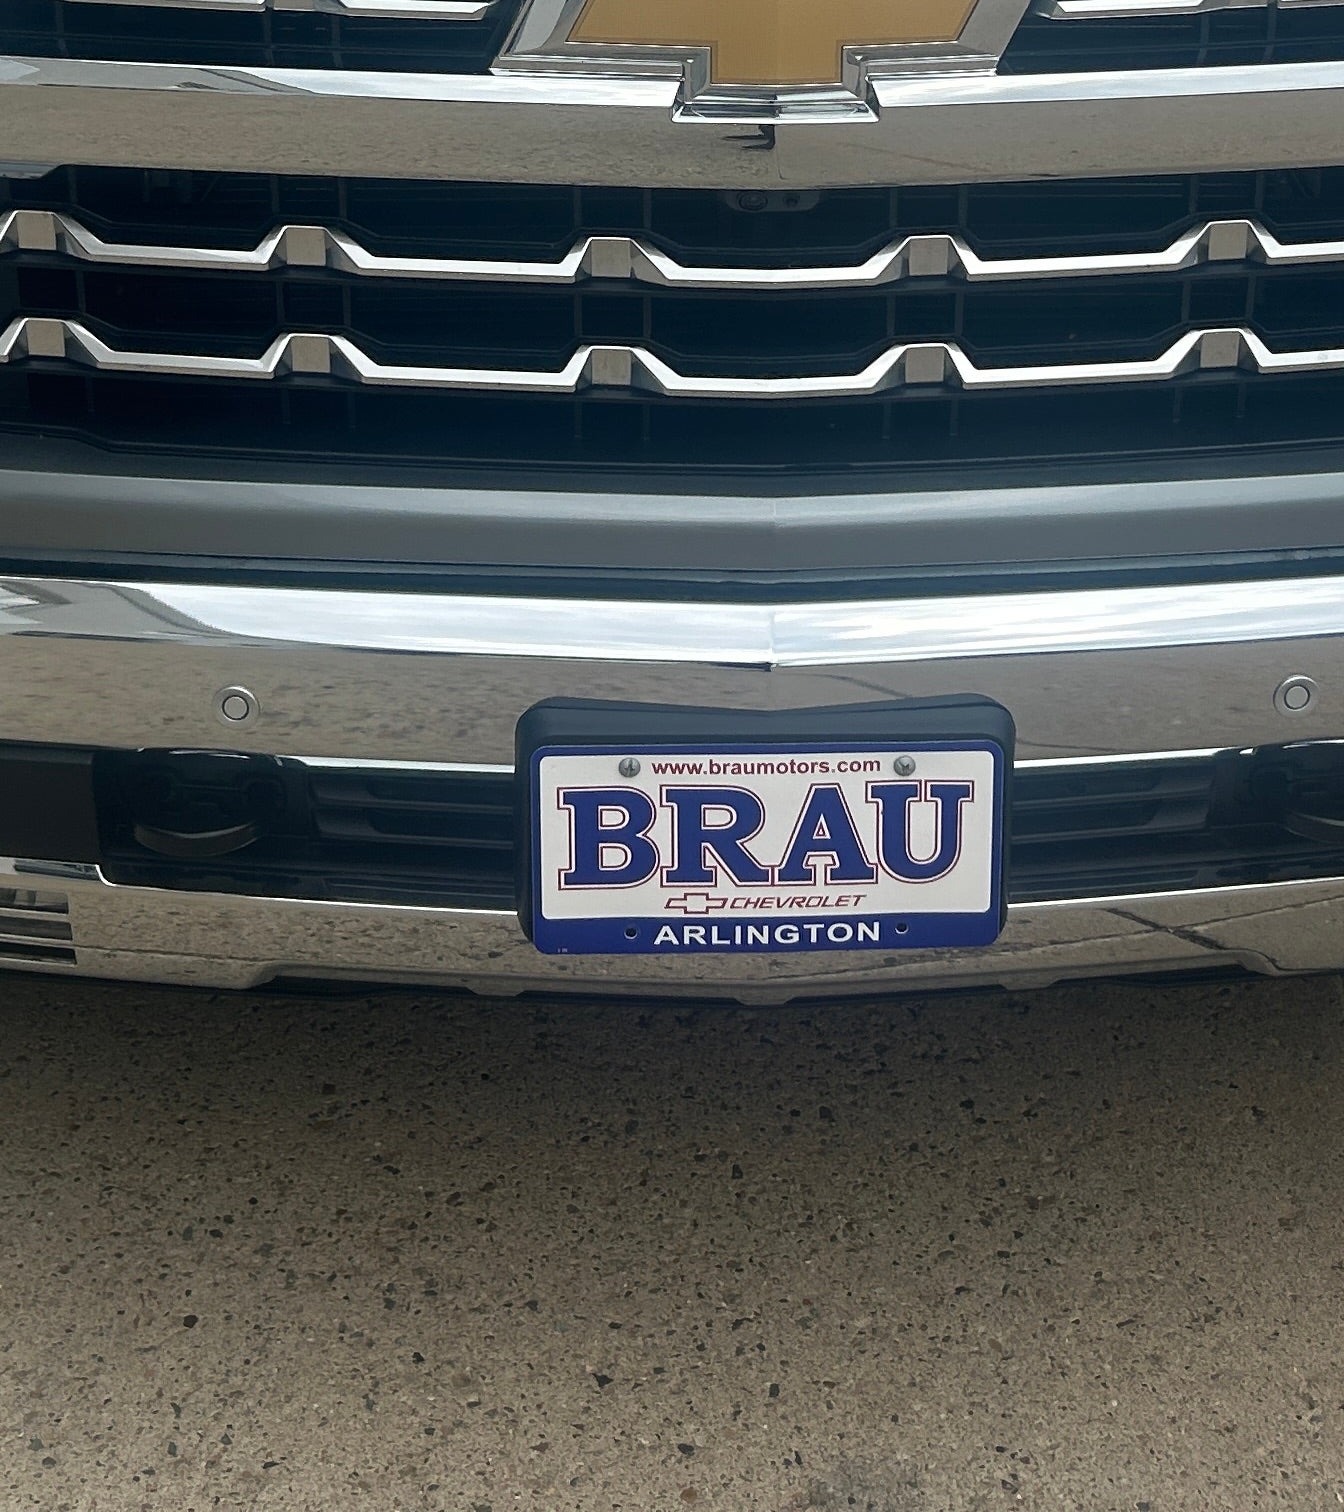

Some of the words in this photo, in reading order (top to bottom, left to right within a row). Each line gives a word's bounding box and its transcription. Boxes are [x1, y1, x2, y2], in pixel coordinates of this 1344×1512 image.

[651, 758, 881, 776] www.braumotors.com
[557, 779, 975, 890] BRAU
[729, 894, 867, 909] CHEVROLET
[653, 921, 881, 946] ARLINGTON
